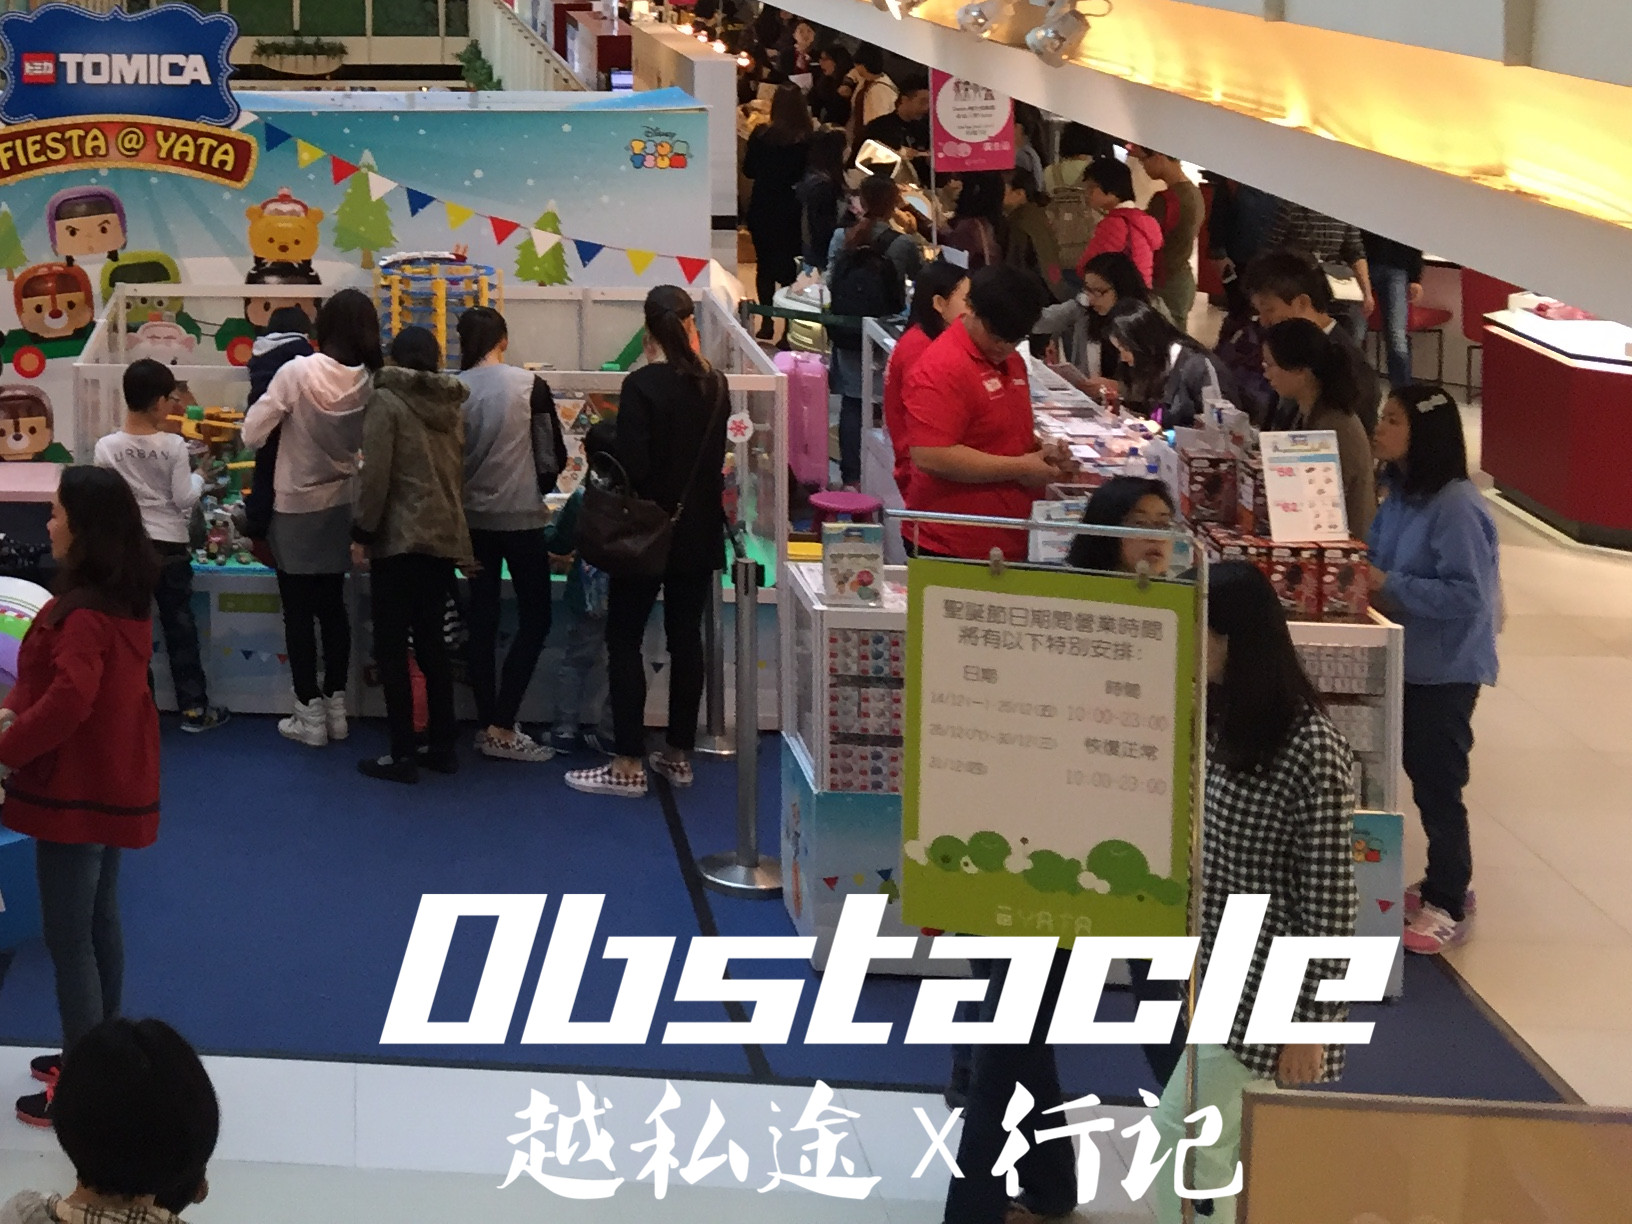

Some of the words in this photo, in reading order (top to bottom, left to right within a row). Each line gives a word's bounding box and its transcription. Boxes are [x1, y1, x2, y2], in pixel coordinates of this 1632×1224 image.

[59, 53, 211, 85] TOMICA
[117, 128, 146, 156] @
[156, 131, 235, 171] YATA
